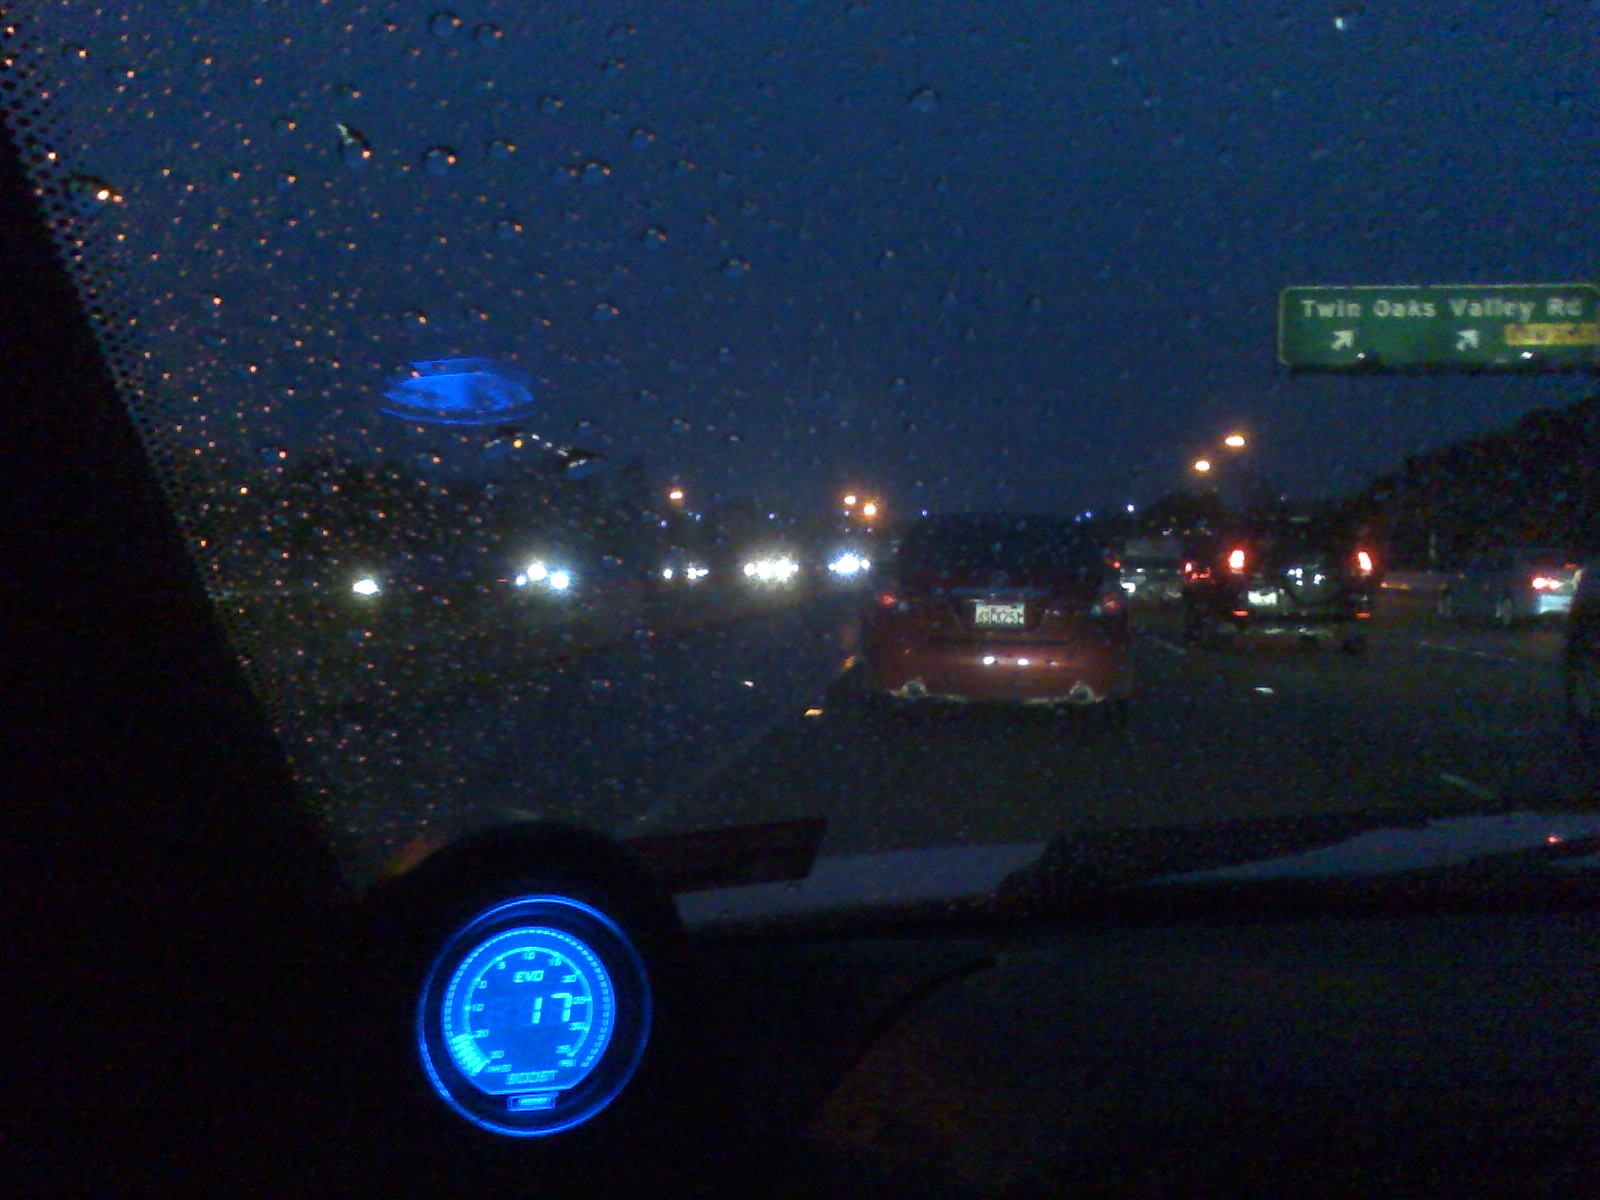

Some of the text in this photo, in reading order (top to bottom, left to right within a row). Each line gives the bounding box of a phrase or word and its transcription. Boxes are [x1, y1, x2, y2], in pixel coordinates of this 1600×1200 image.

[1301, 298, 1362, 318] Twin
[1373, 298, 1437, 318] Oaks
[1448, 298, 1536, 322] Valley
[513, 970, 545, 983] EVO
[531, 992, 573, 1025] 17
